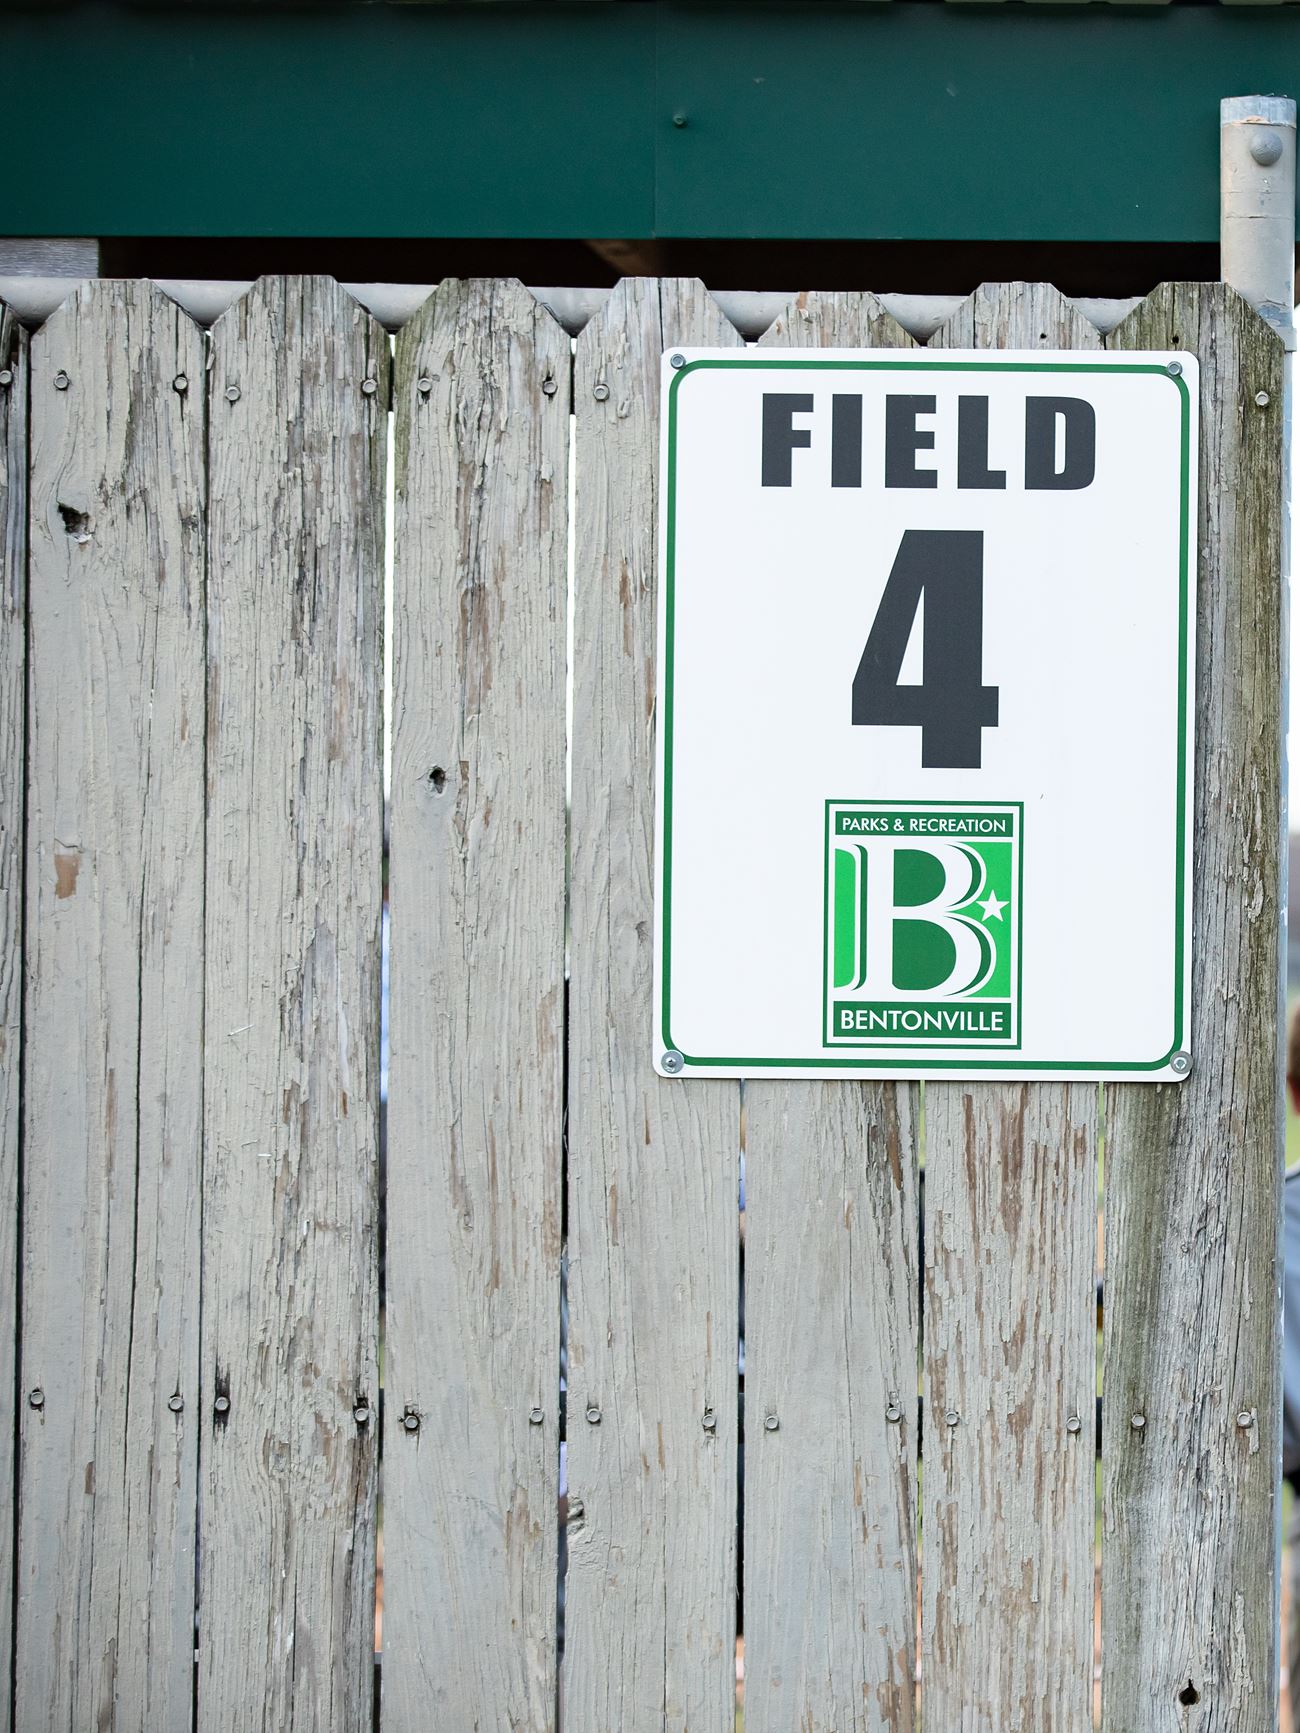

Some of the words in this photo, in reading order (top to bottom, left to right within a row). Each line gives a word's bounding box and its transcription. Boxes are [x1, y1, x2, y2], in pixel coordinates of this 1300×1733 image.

[761, 393, 1096, 491] FIELD
[852, 529, 1000, 770] 4
[842, 817, 889, 832] PARKS
[893, 818, 905, 832] &
[909, 818, 1006, 833] RECREATION
[851, 842, 997, 999] B
[840, 1009, 1004, 1032] BENTONVILLE
